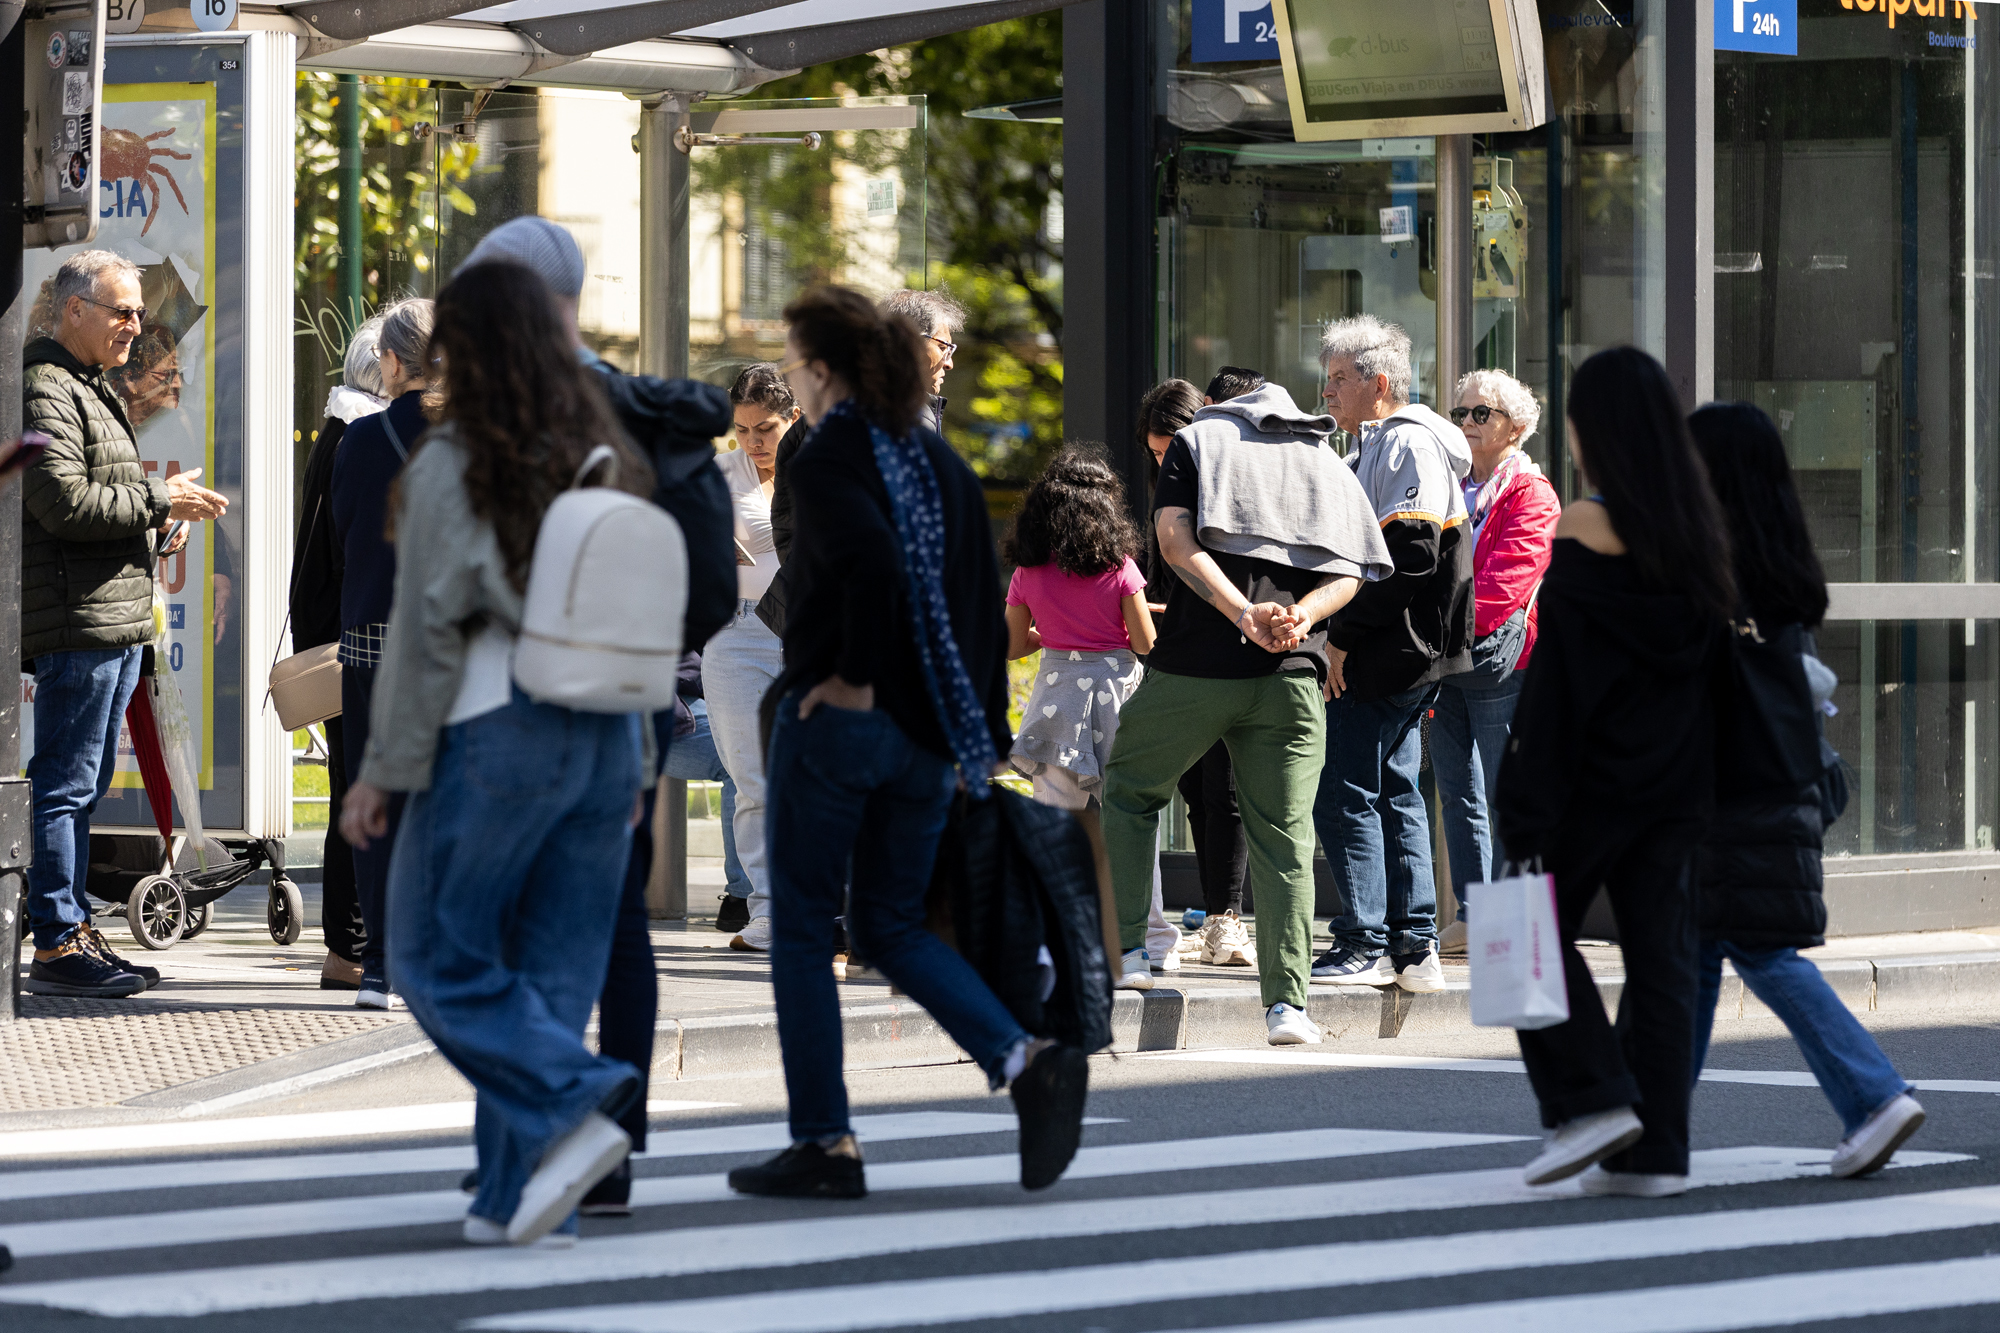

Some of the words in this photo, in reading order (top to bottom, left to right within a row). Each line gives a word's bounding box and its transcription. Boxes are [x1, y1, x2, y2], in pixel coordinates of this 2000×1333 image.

[1752, 12, 1780, 37] 24h
[1928, 31, 1977, 49] Boulevard
[222, 61, 237, 70] 354
[1361, 80, 1395, 96] Viaja
[1400, 81, 1416, 92] en
